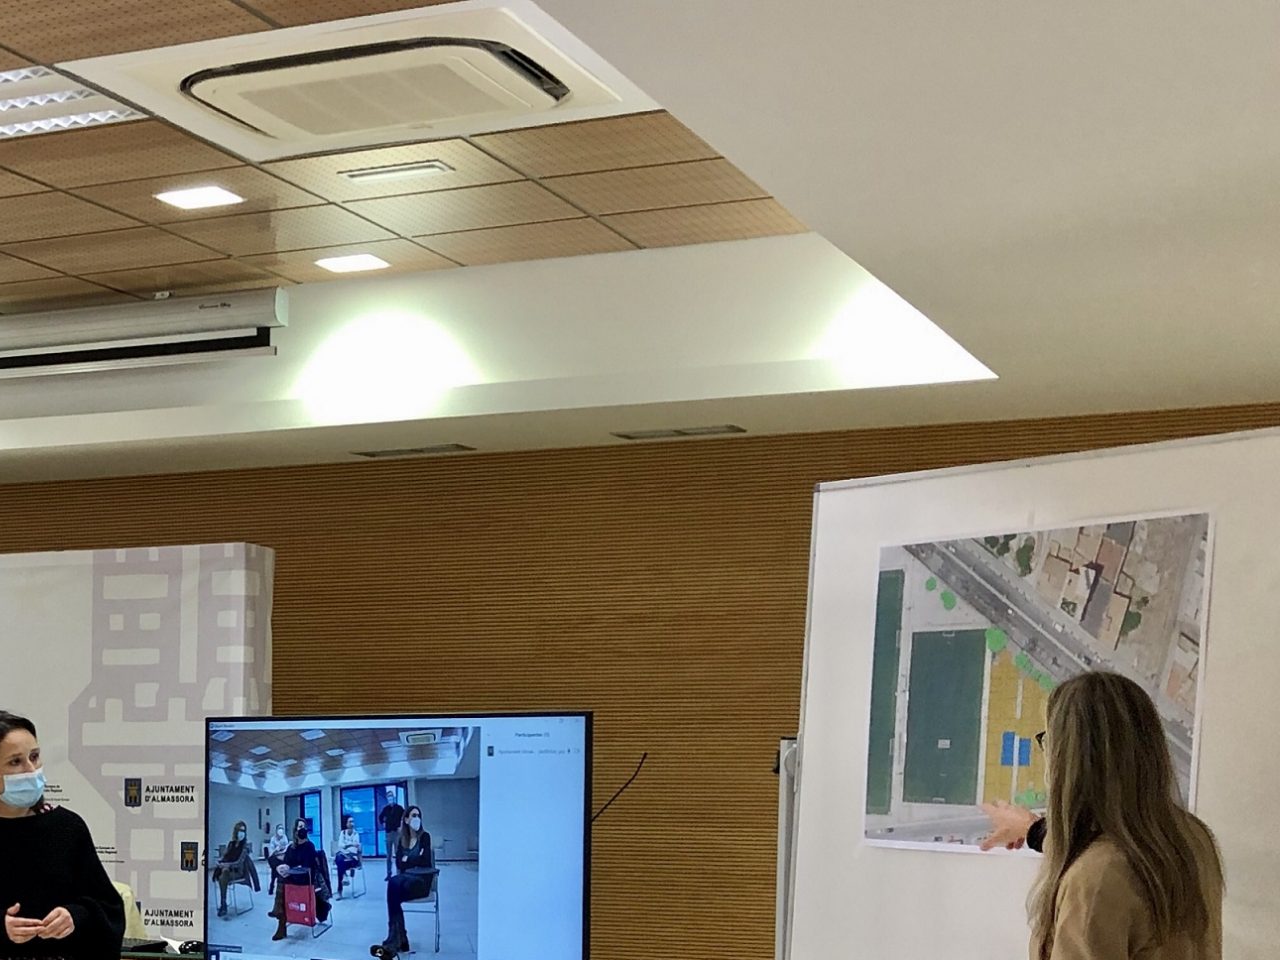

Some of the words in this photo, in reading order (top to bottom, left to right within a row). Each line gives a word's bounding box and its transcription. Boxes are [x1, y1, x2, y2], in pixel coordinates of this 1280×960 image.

[145, 785, 195, 793] AJUNTAMENT
[144, 794, 195, 803] D'ALMASSORA
[145, 909, 194, 918] AJUNTAMENT
[144, 918, 194, 927] D'ALMASSORA
